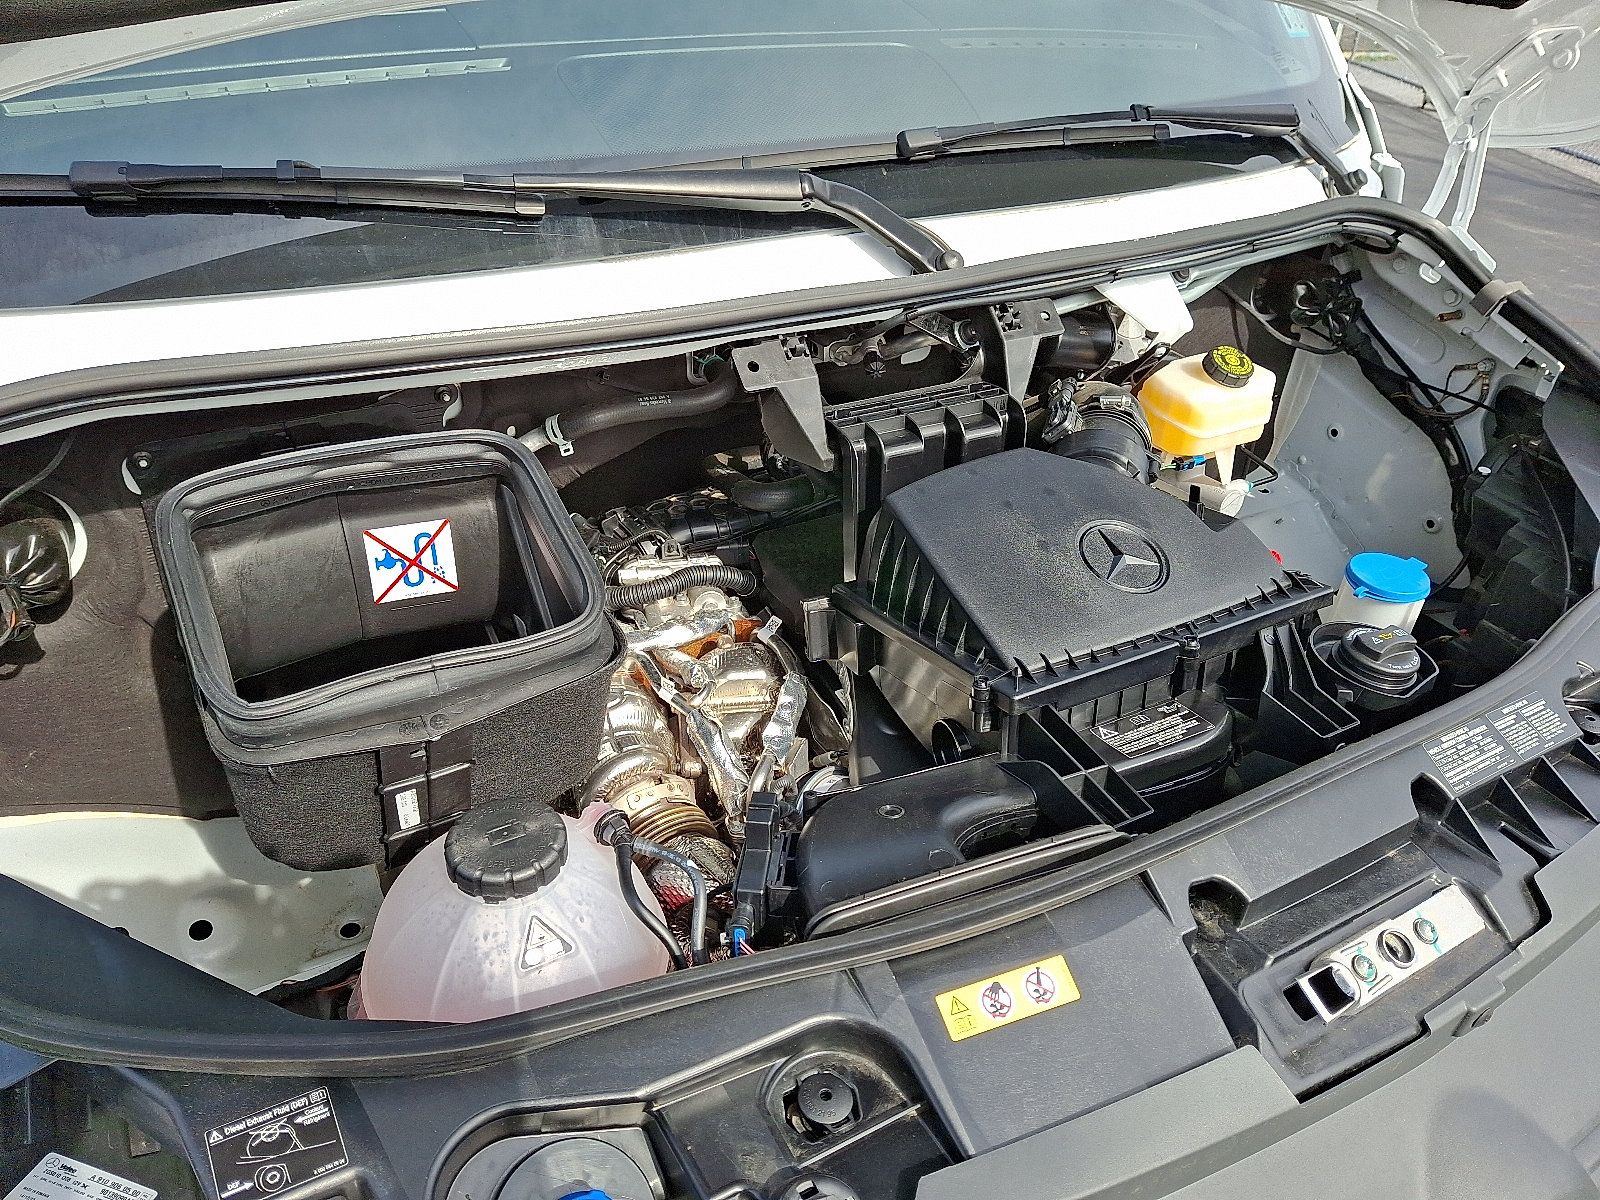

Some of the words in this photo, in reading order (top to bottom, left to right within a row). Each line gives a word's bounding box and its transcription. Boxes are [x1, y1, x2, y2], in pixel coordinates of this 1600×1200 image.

[224, 1123, 246, 1136] Diesel
[247, 1112, 274, 1127] Exhaust
[274, 1106, 290, 1118] Fluid
[290, 1098, 309, 1111] (DEF)
[227, 1181, 240, 1190] DEF
